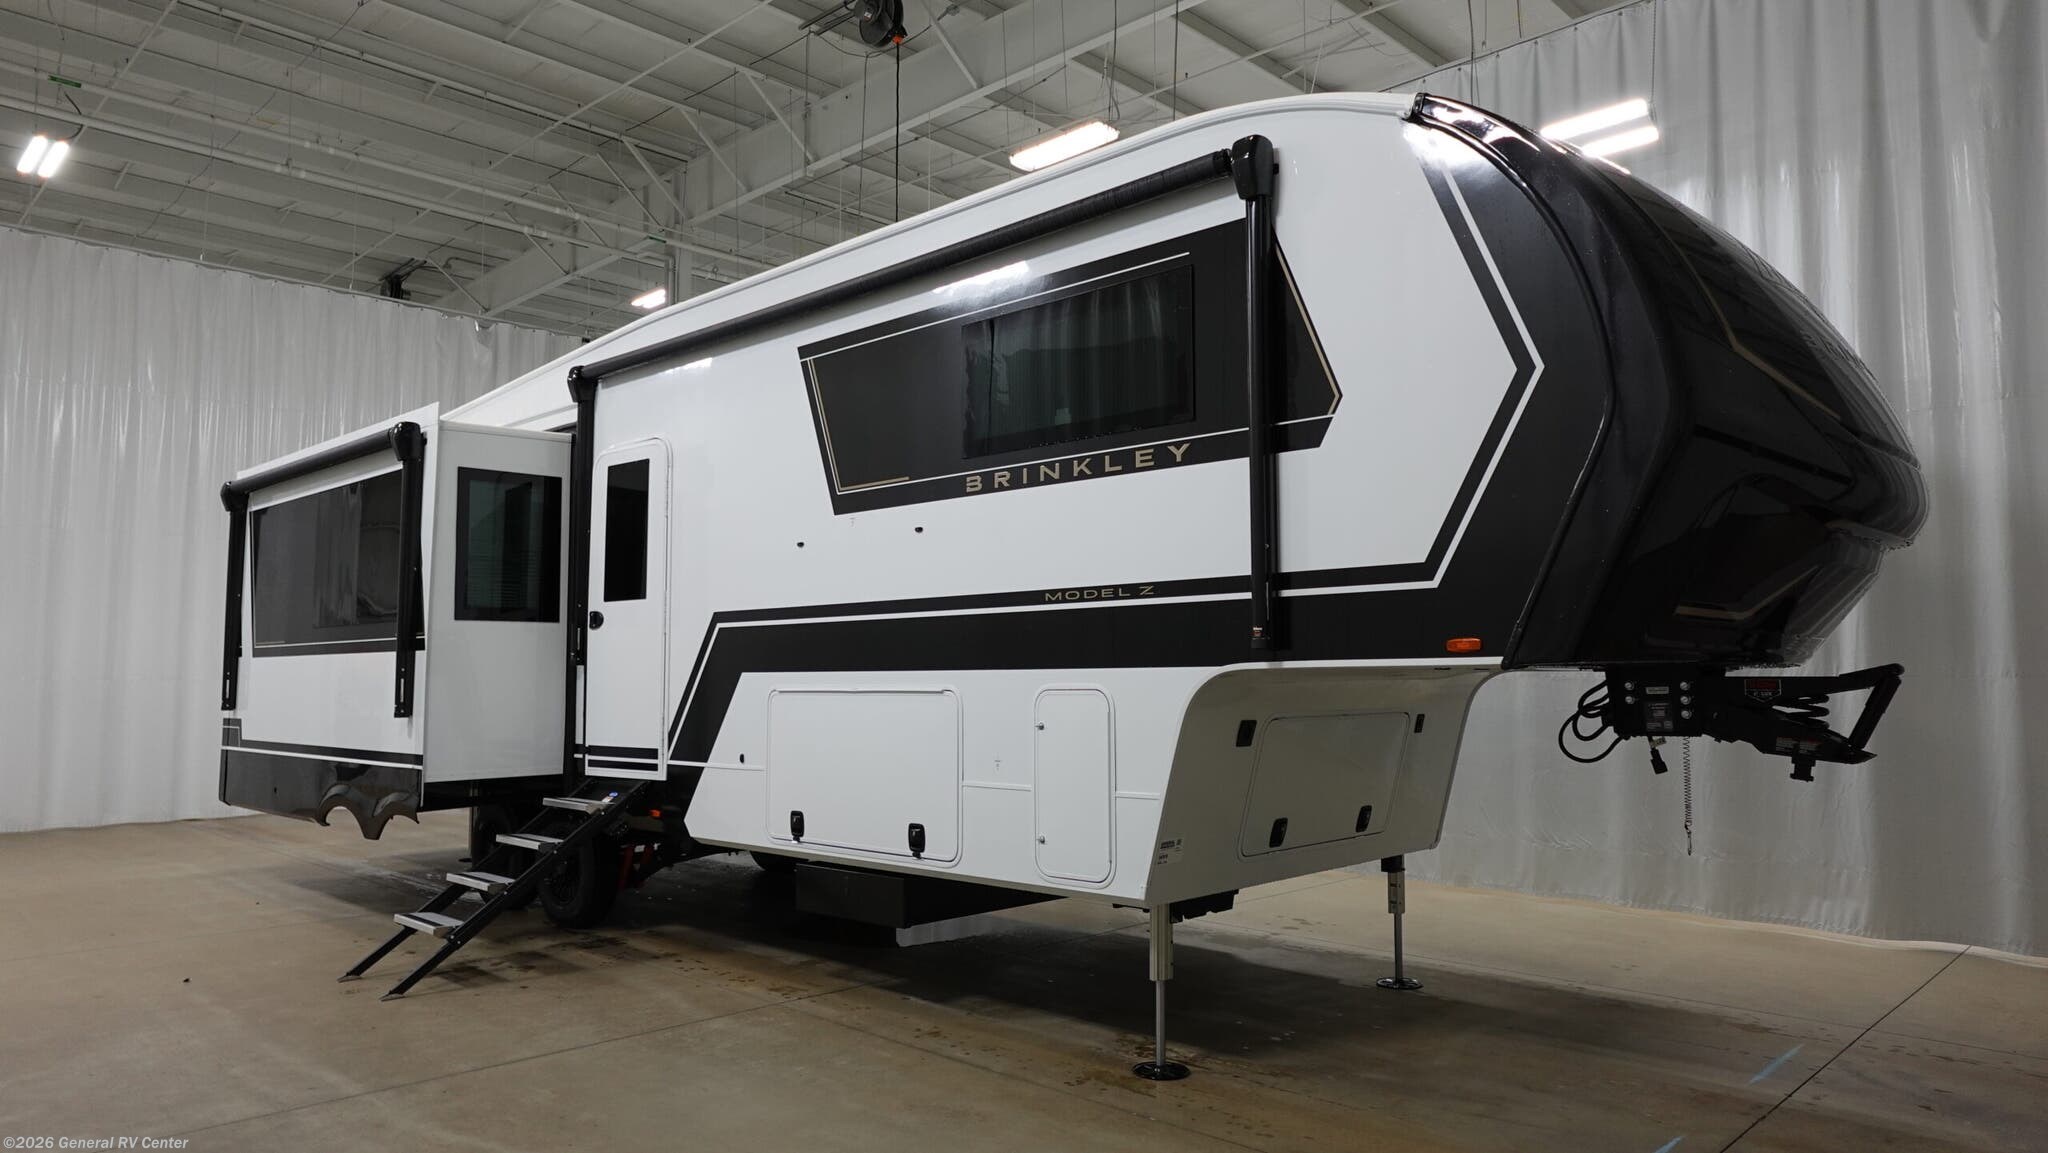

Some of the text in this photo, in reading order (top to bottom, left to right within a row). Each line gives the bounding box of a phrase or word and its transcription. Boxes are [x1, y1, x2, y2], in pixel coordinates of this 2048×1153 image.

[965, 443, 1191, 493] BRINKLEY
[1045, 585, 1155, 602] MODEL Z
